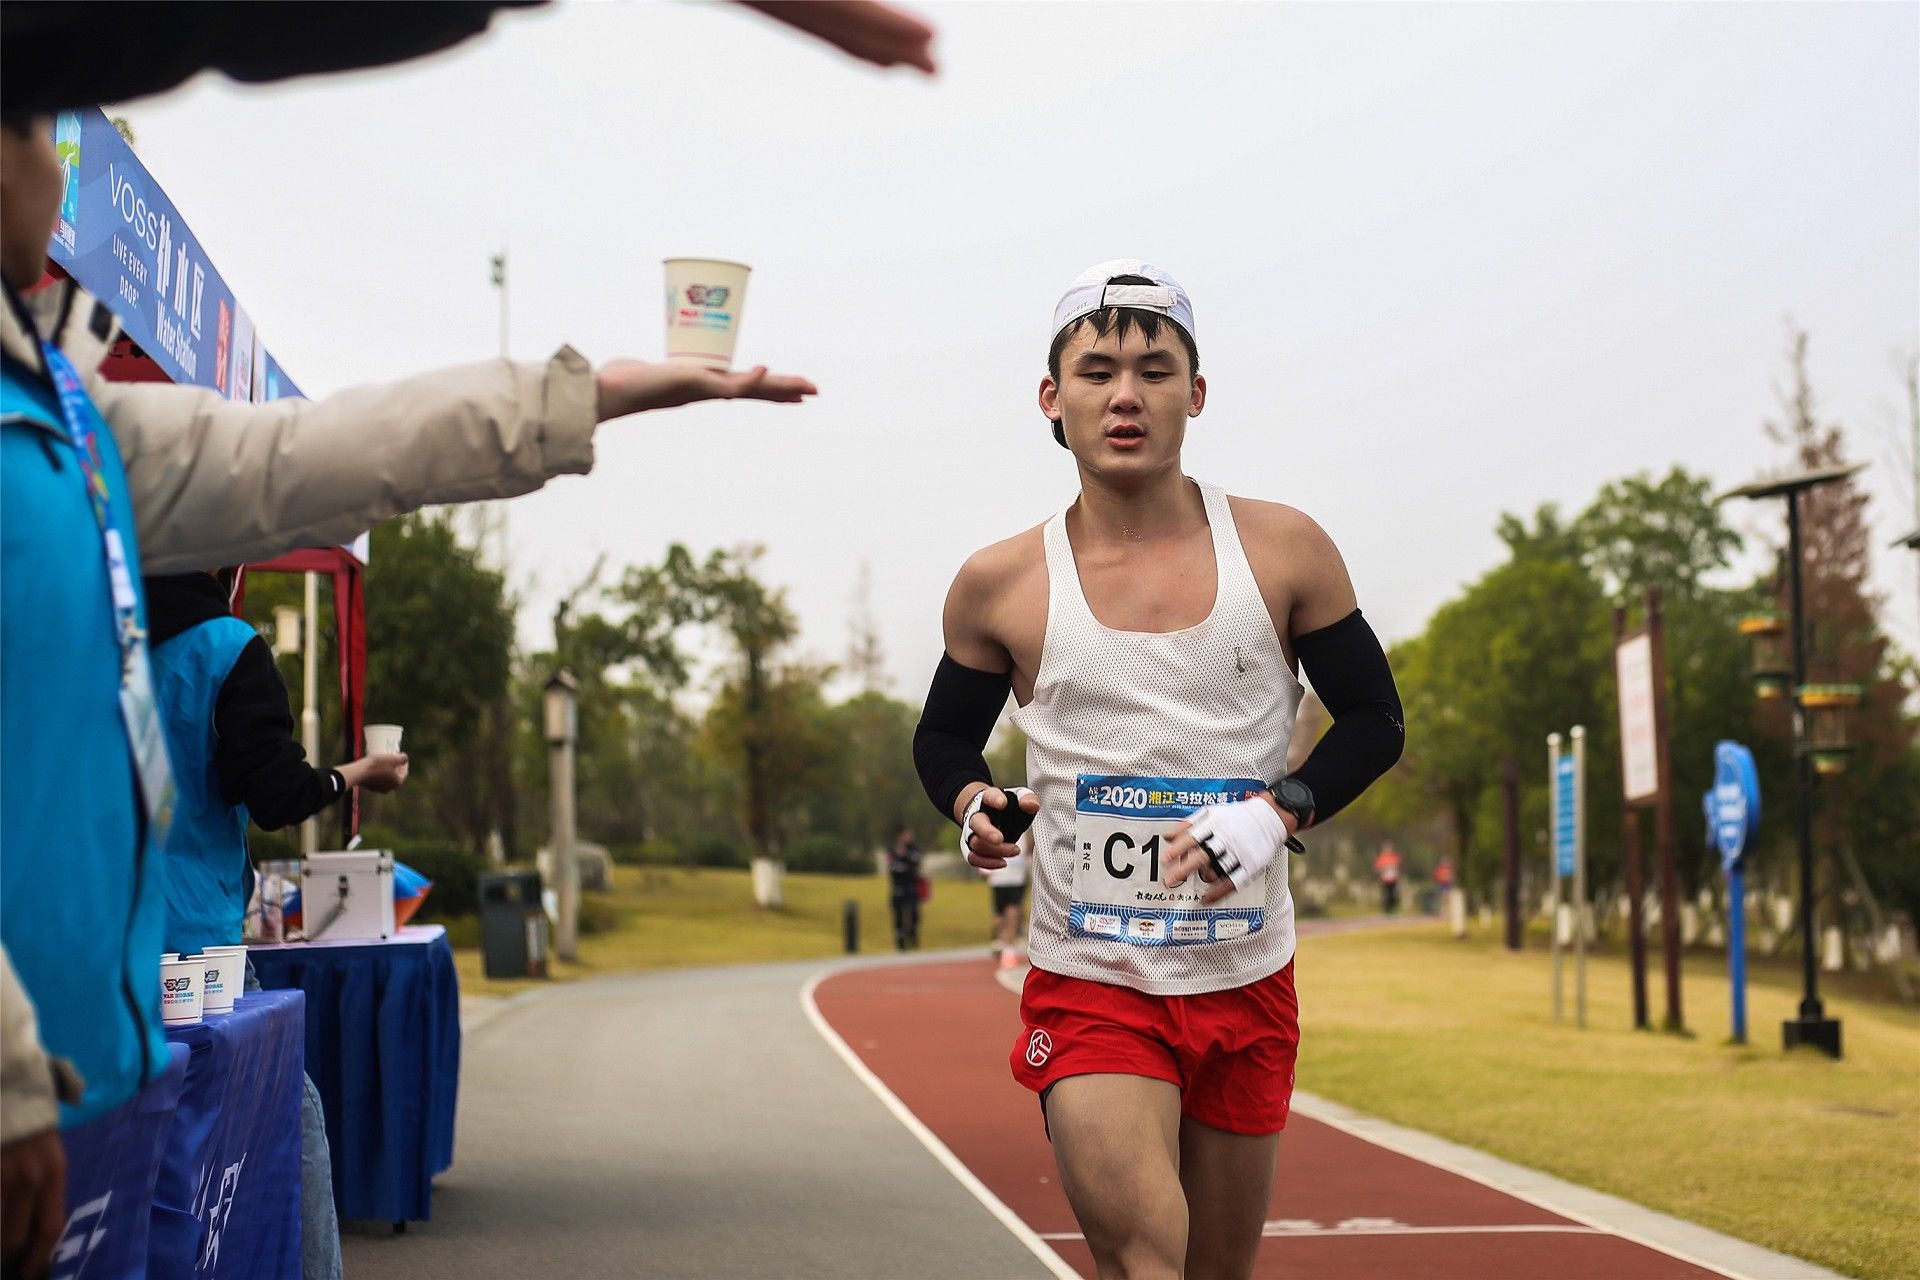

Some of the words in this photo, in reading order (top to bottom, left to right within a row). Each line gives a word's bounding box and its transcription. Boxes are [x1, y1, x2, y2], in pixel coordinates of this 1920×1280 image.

[110, 162, 157, 251] VOSS
[113, 233, 128, 266] LIVE
[128, 251, 148, 287] EVERY
[156, 299, 176, 358] Water
[175, 322, 197, 381] Station
[1100, 785, 1148, 810] 2020
